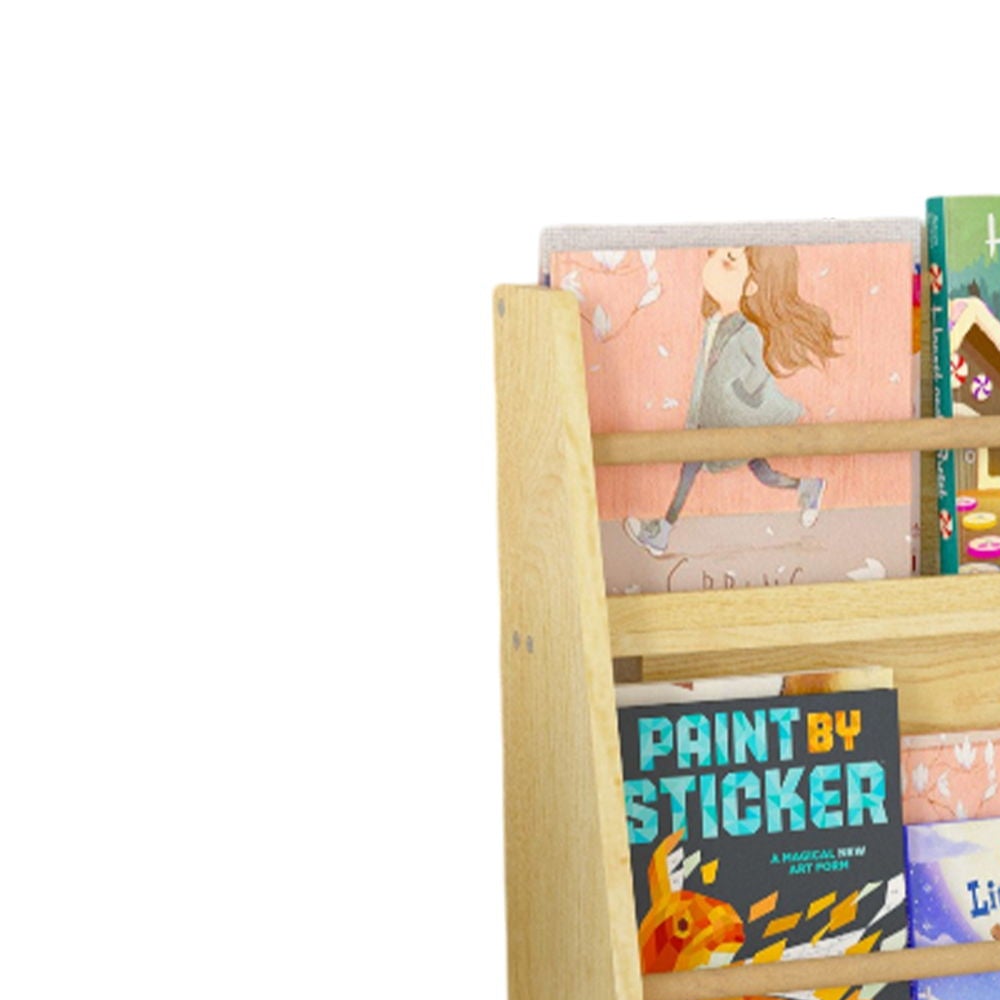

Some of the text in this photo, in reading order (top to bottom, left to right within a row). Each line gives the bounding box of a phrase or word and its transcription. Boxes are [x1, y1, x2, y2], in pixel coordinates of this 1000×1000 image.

[638, 707, 861, 771] PAINT BY
[624, 761, 888, 845] STICKER
[782, 848, 835, 863] MAGICAL
[815, 859, 849, 872] FORM
